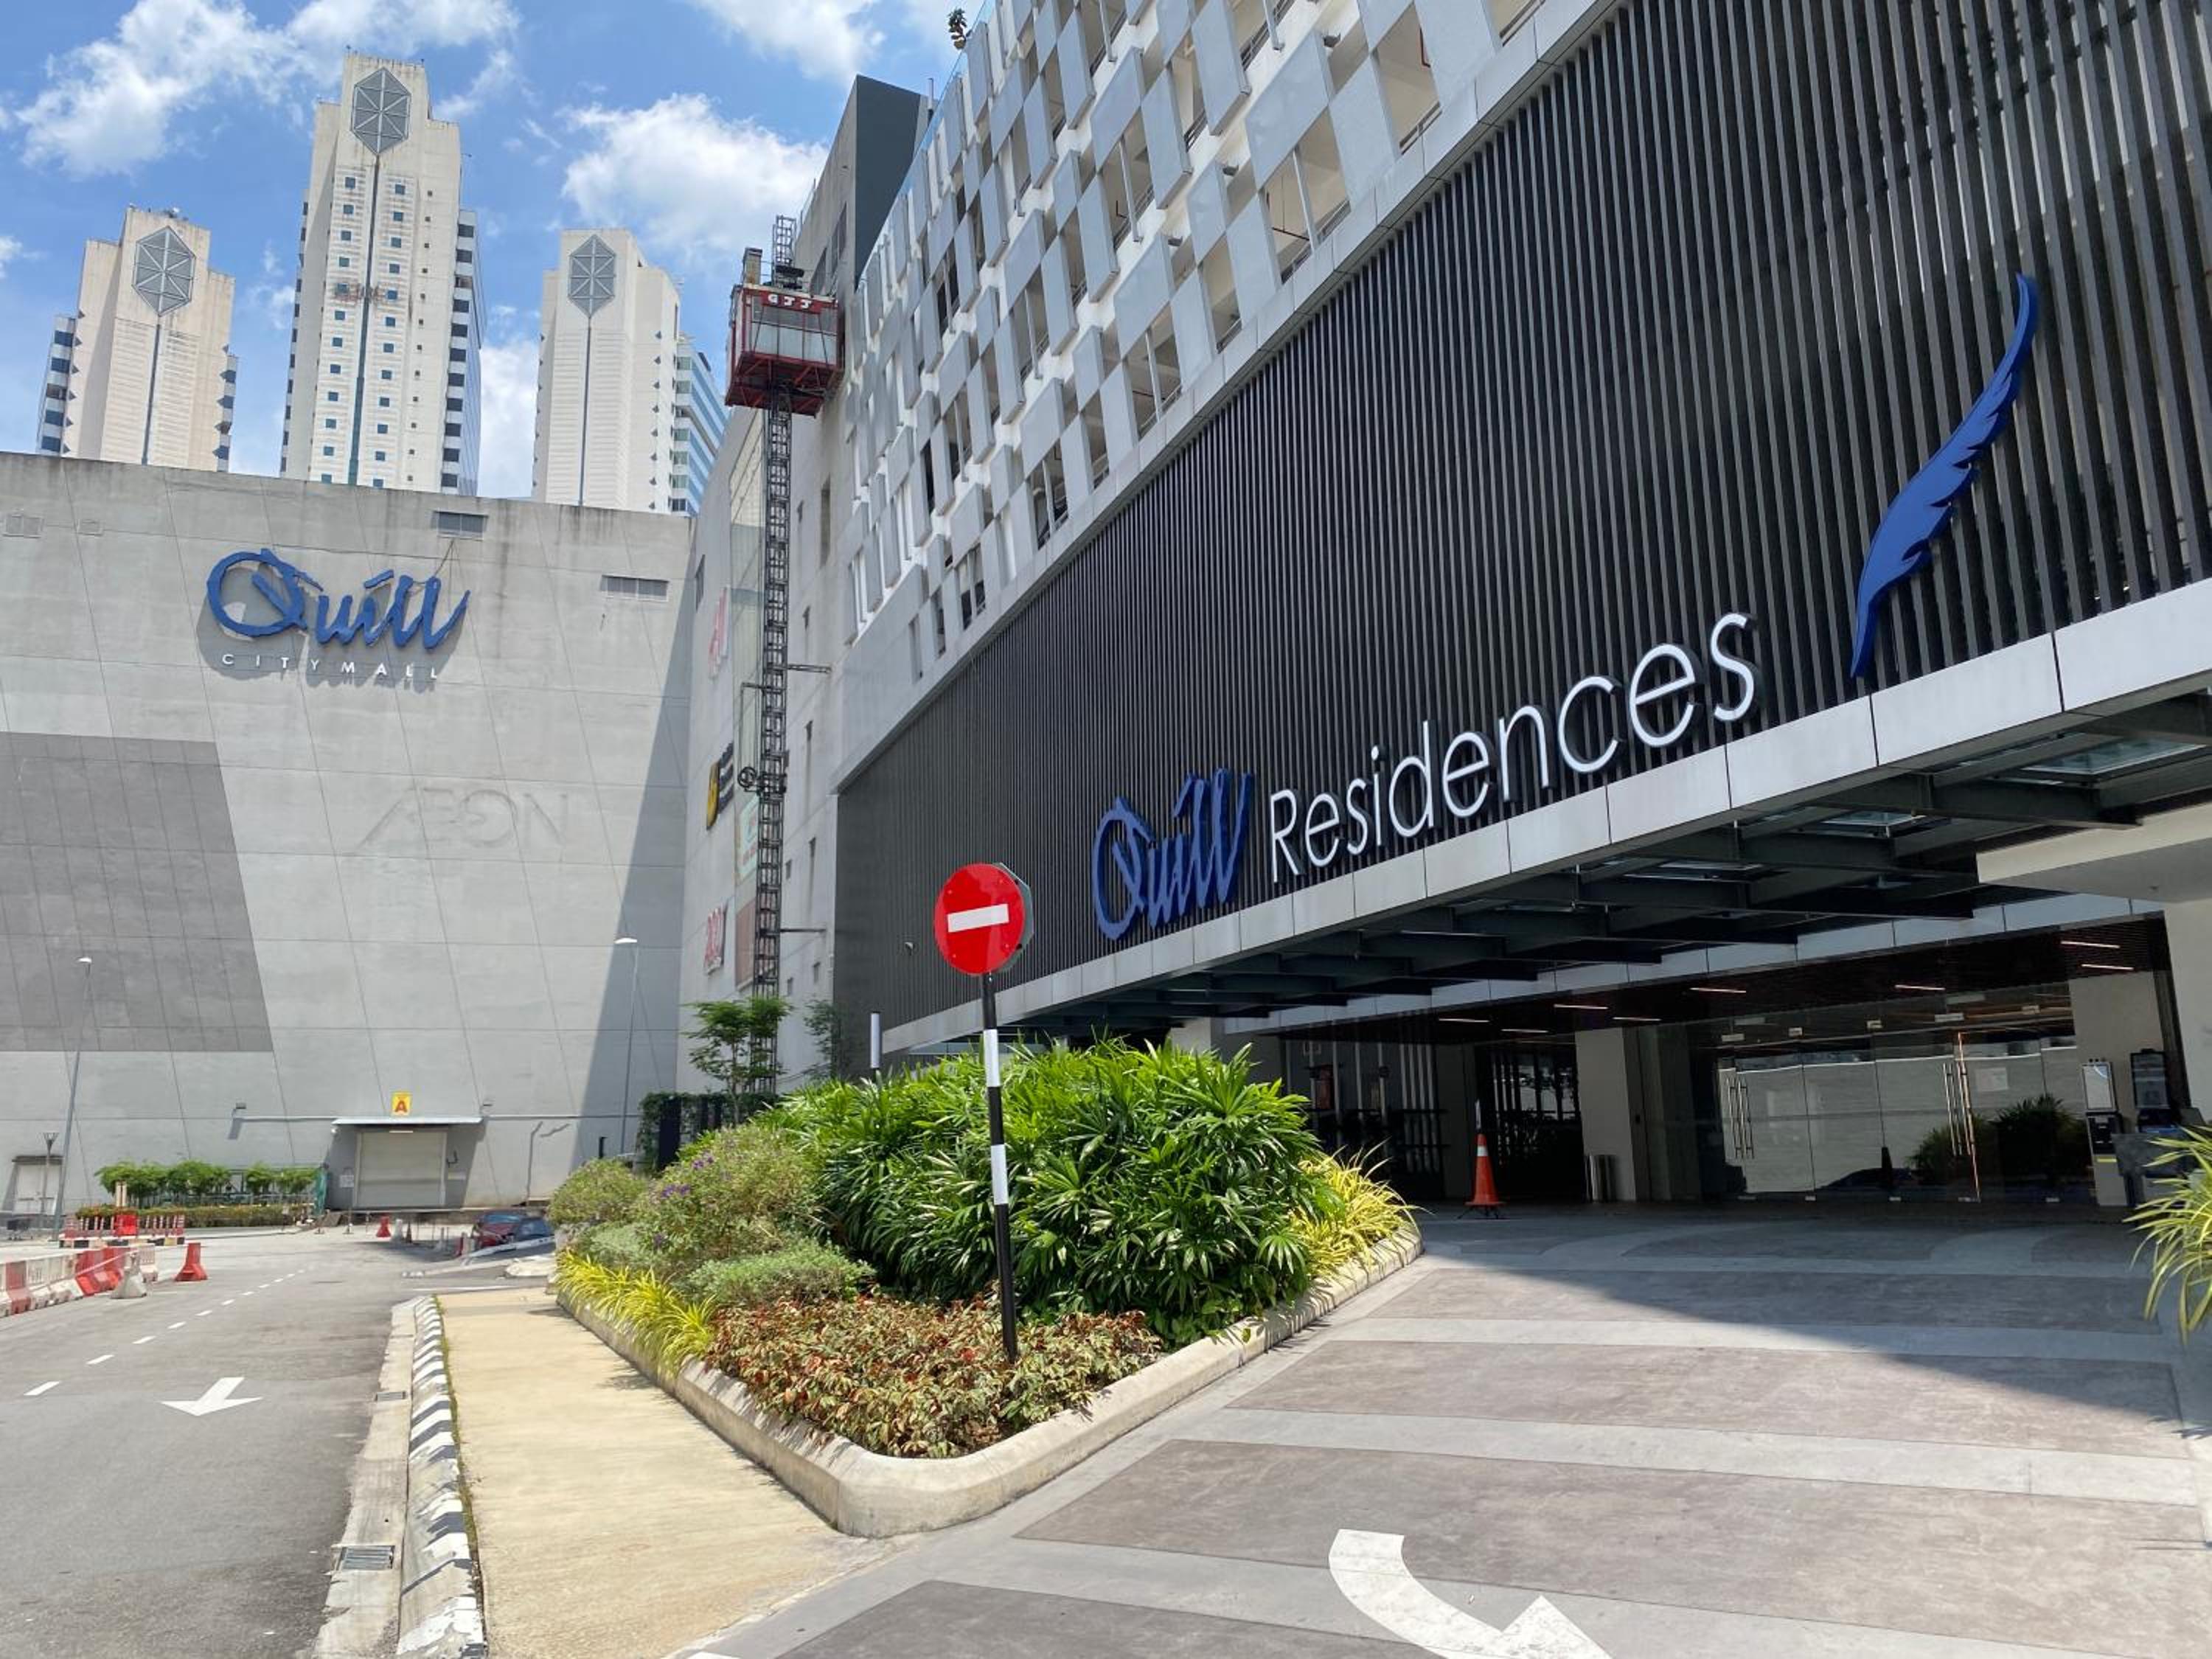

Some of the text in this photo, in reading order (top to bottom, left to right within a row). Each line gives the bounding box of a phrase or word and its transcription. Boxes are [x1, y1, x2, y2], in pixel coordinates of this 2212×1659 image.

[206, 548, 471, 650] Quill
[1093, 613, 1756, 940] Quill Residences
[394, 1099, 408, 1113] A
